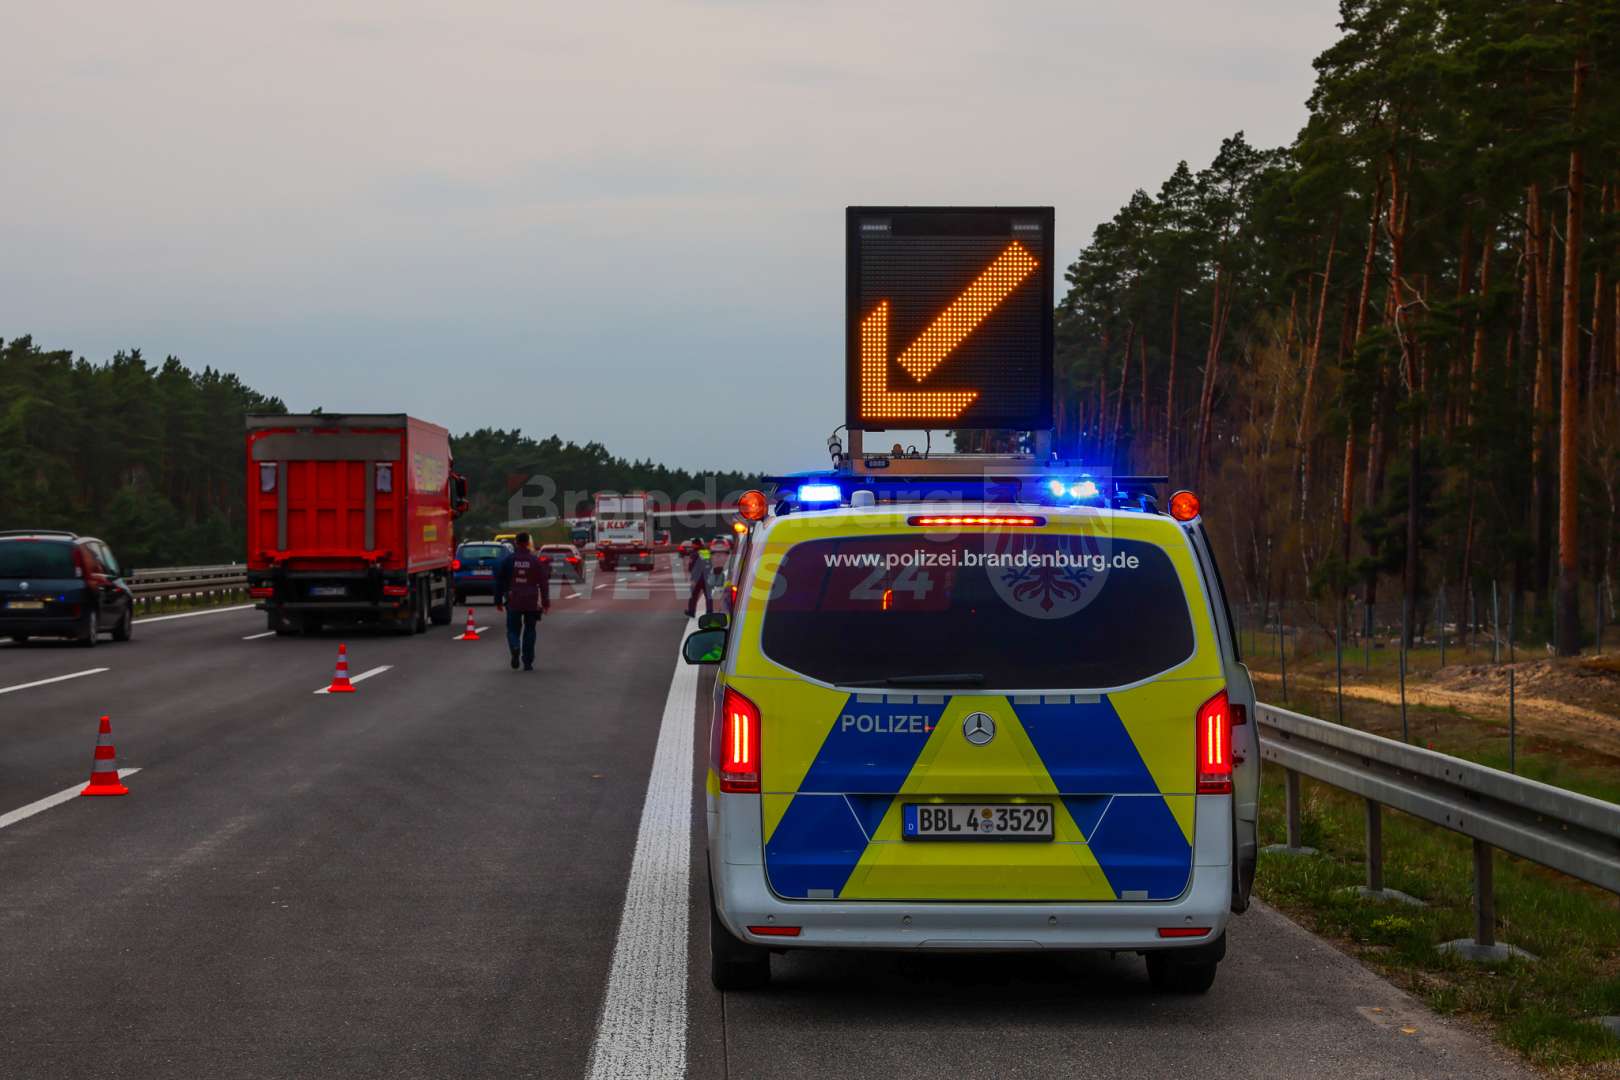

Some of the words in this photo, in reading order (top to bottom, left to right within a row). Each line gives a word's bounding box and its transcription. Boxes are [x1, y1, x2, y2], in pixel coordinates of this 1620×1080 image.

[824, 550, 1140, 572] www.polizei.brandenburg.de
[841, 714, 929, 733] POLIZEI
[908, 823, 914, 831] D
[919, 809, 960, 831] BBL
[967, 809, 979, 831] 4
[996, 809, 1049, 831] 3529
